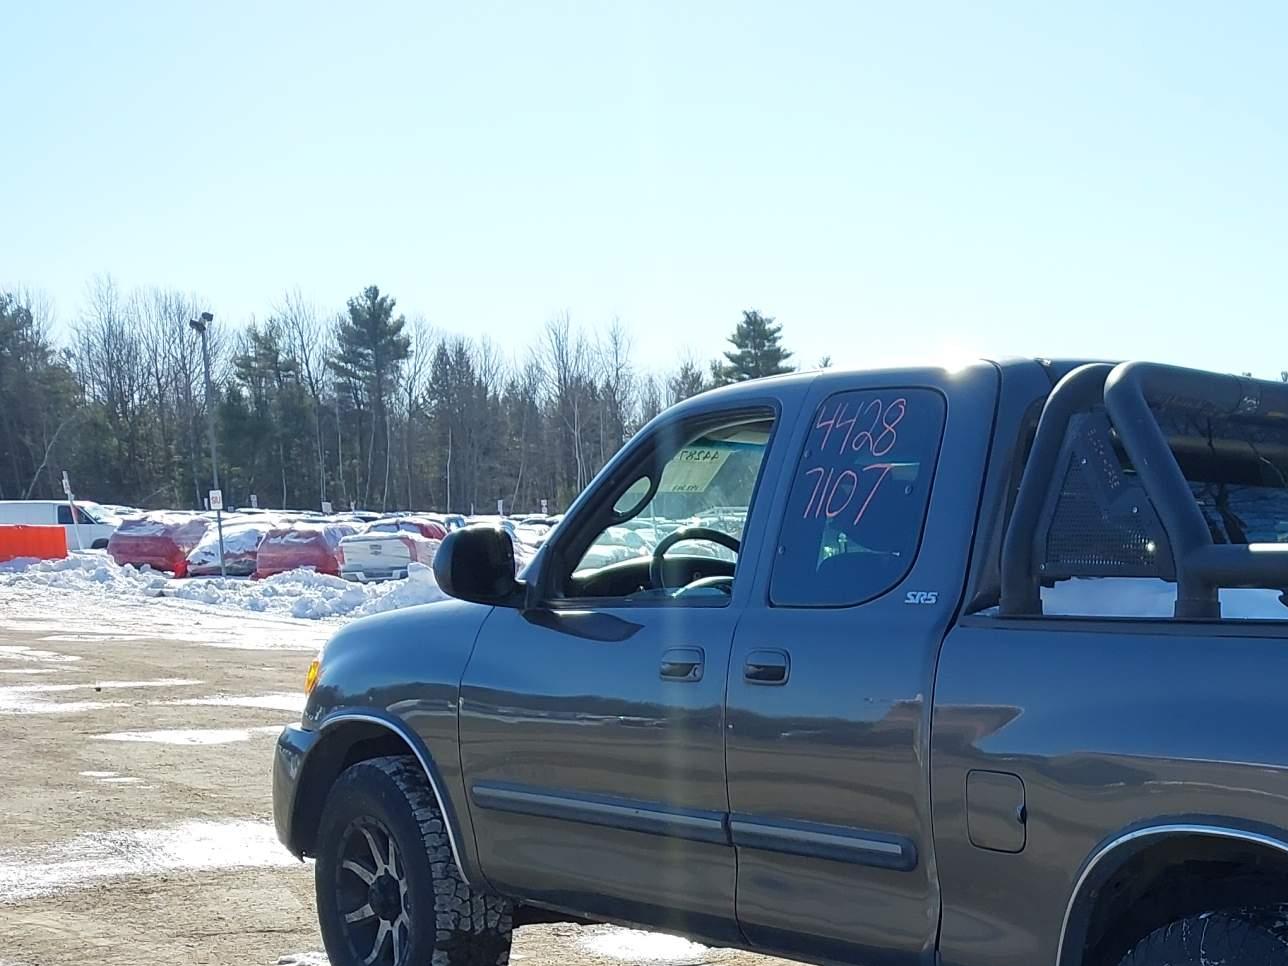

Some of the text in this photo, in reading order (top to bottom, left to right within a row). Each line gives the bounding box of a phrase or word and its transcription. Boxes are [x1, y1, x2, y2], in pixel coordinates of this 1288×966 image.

[816, 398, 906, 457] 4428
[803, 462, 893, 525] 7107
[904, 591, 938, 604] SR5
